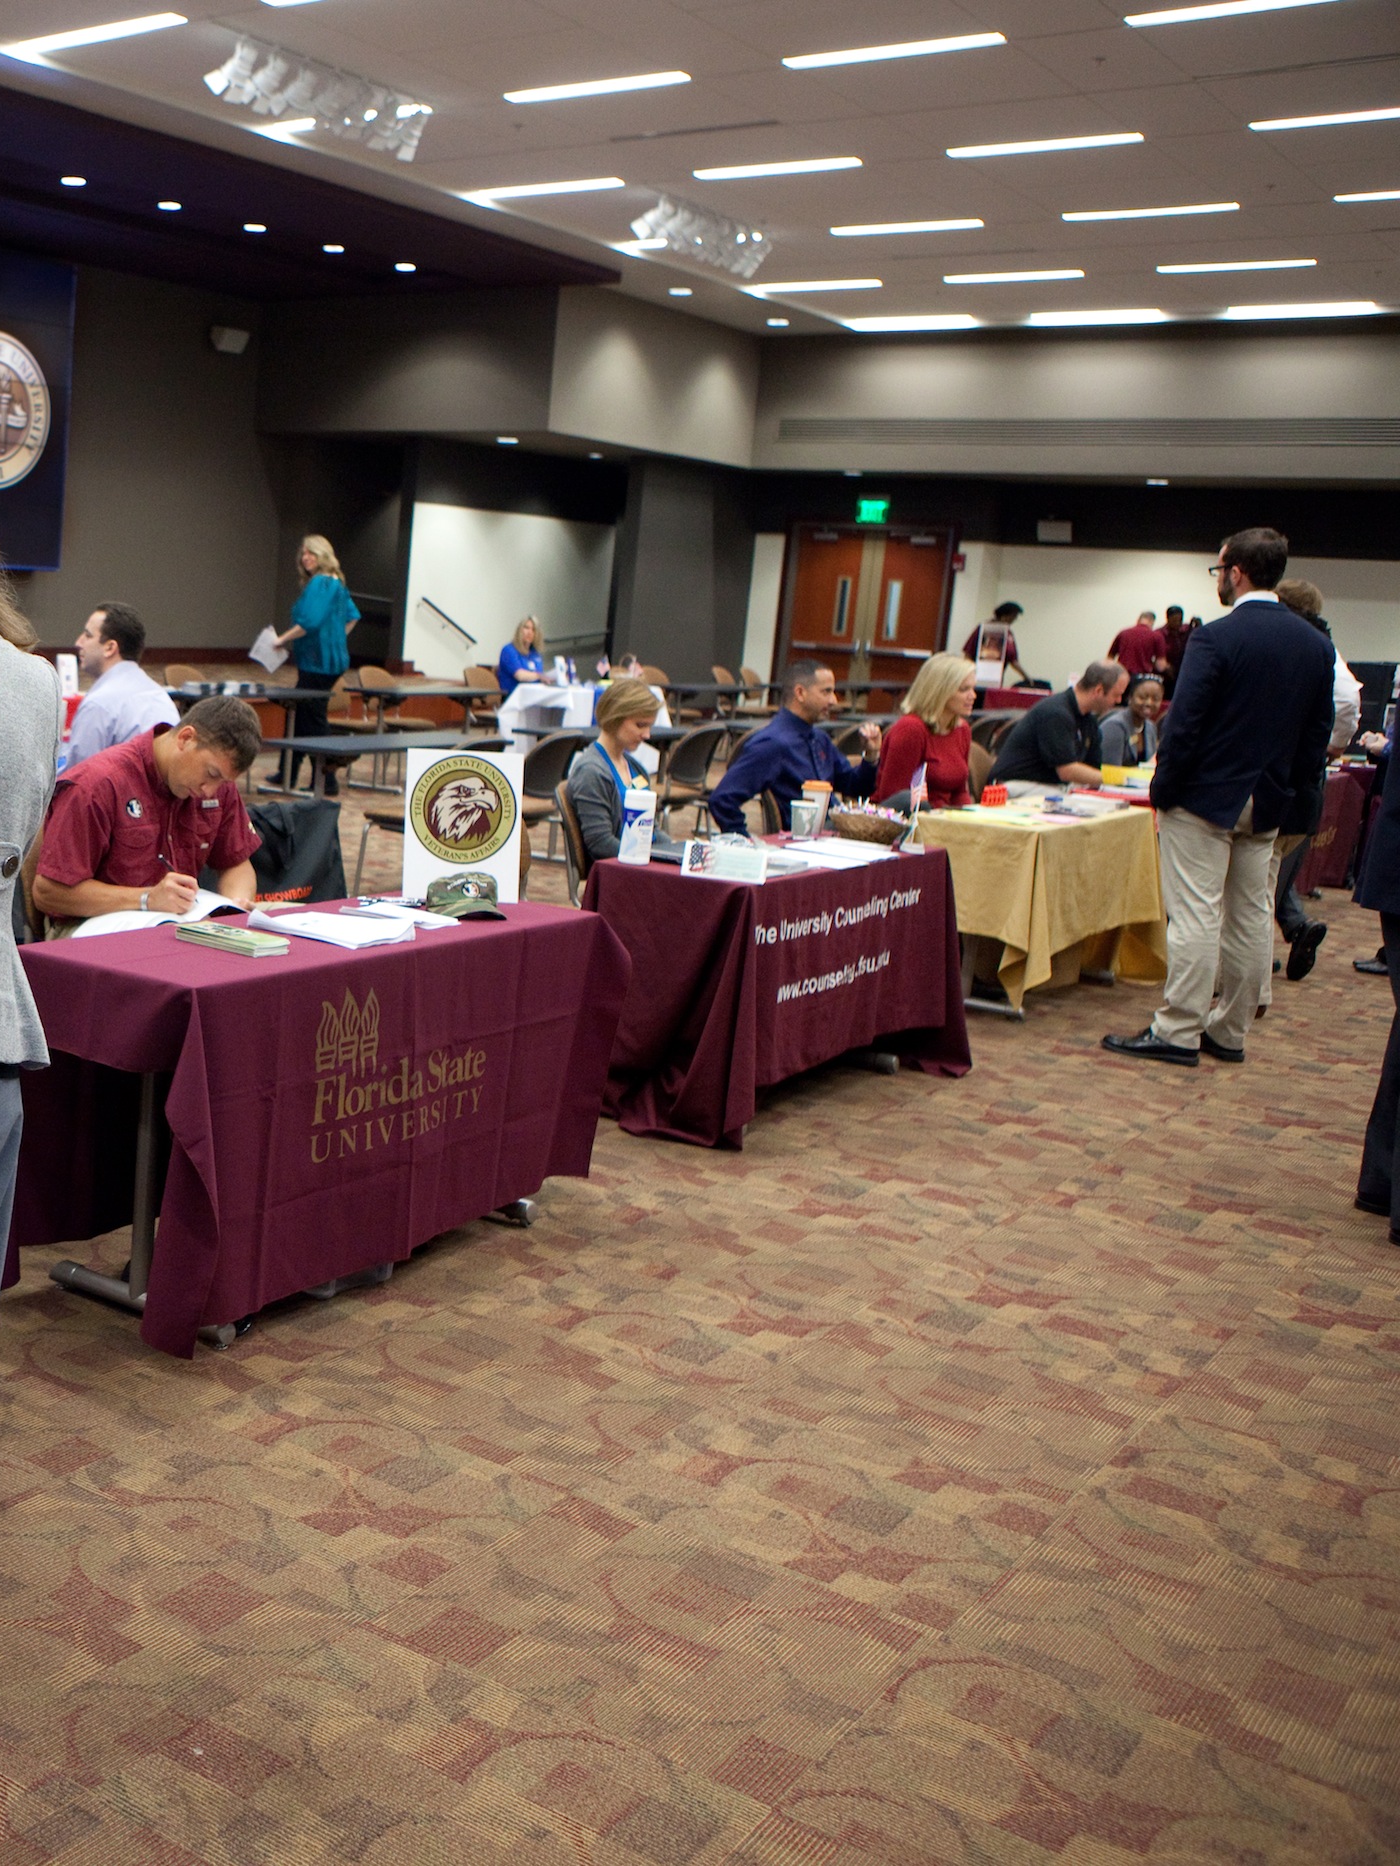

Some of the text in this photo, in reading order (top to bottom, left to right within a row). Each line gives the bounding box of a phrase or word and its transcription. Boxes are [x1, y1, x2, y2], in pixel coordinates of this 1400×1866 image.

[419, 762, 451, 793] FLORIDA
[453, 759, 483, 769] STATE
[484, 767, 511, 822] UNIVERSITY
[424, 835, 500, 860] VETERAN'S AFFAIRS
[780, 911, 833, 941] University
[835, 896, 888, 929] Couneling
[311, 1046, 486, 1126] Florida State
[310, 1085, 483, 1163] UNIVERSITY
